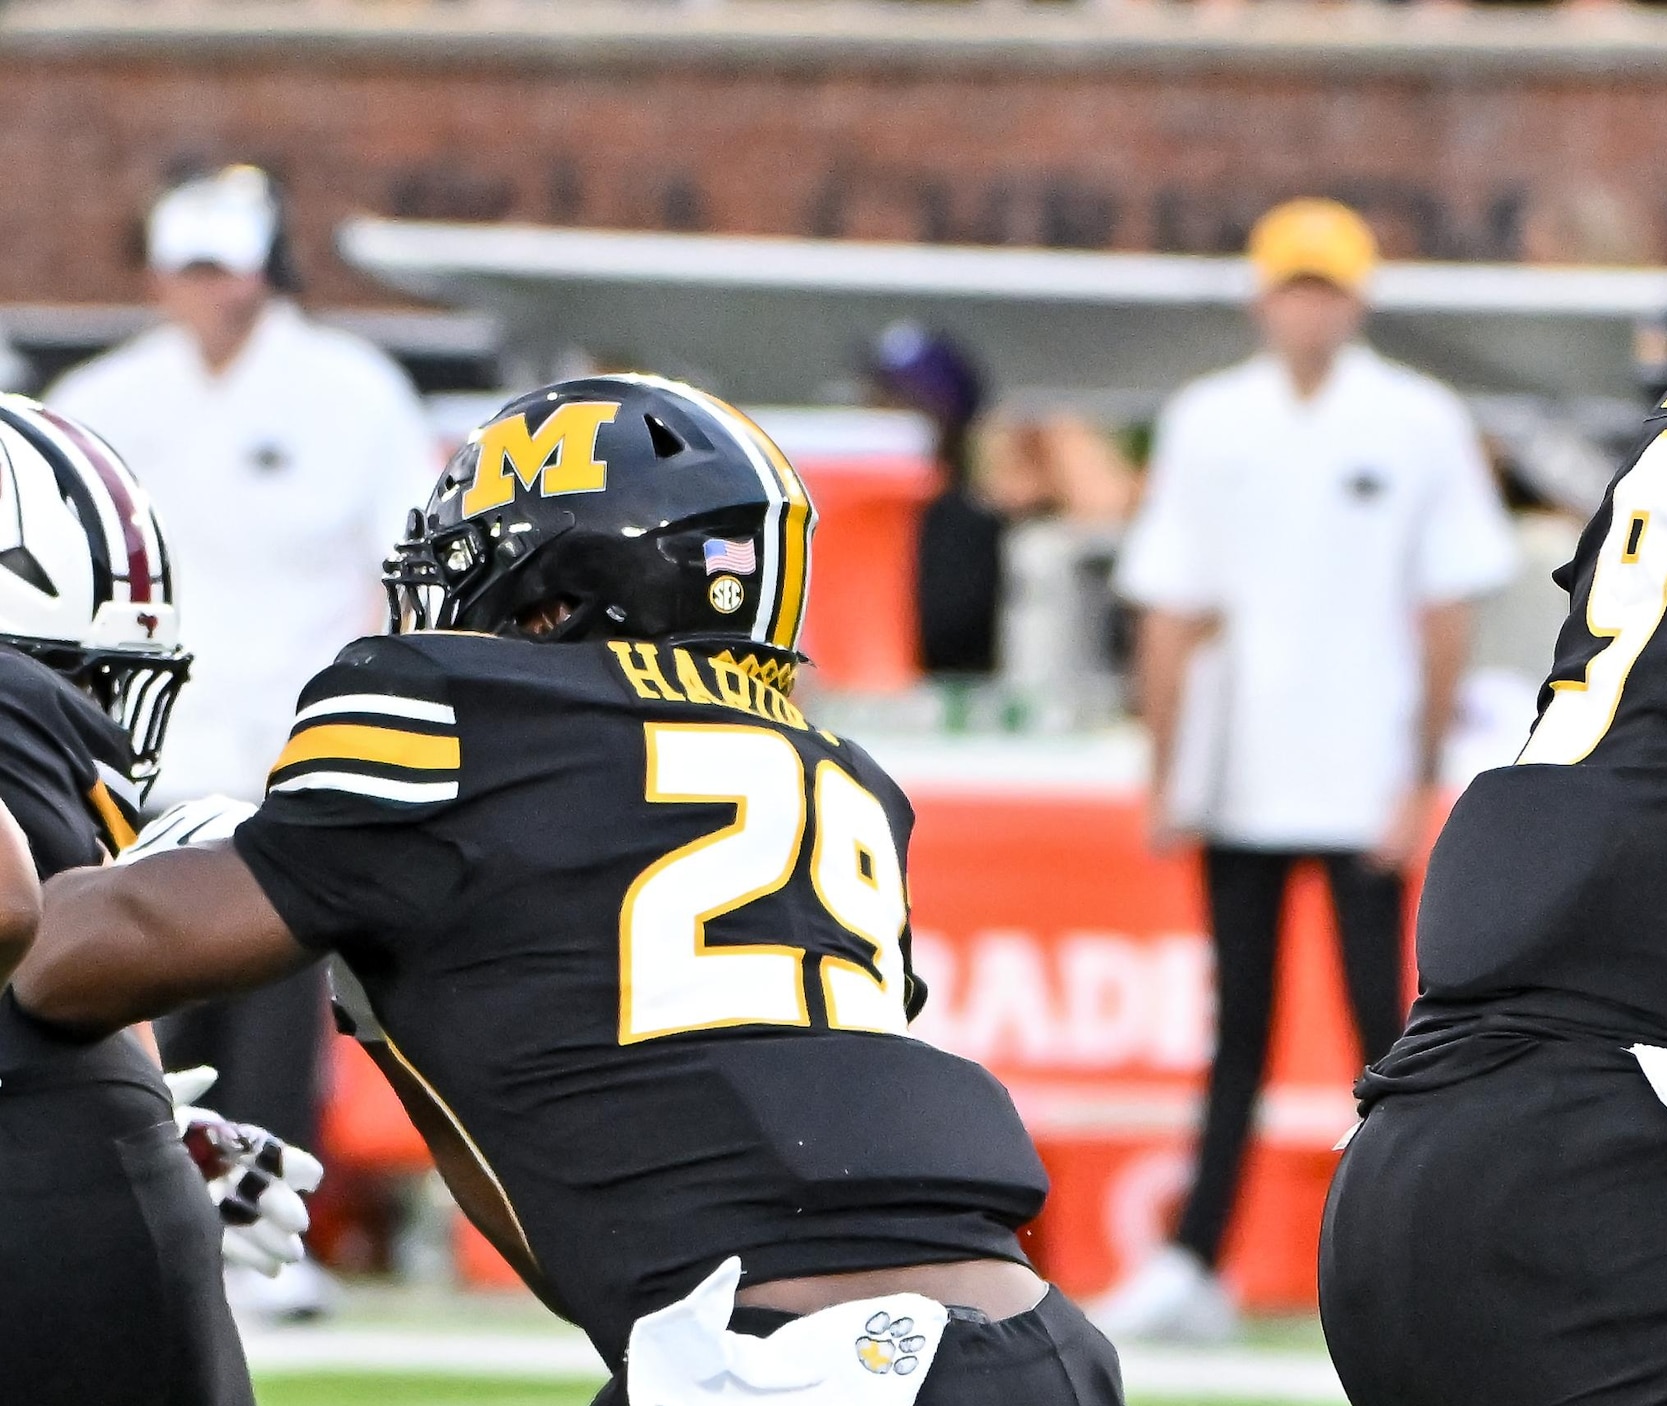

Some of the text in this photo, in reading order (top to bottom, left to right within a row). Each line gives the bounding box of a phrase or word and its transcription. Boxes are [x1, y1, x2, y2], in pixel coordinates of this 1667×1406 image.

[462, 401, 622, 520] M
[711, 579, 743, 609] SEC
[619, 722, 910, 1045] 29
